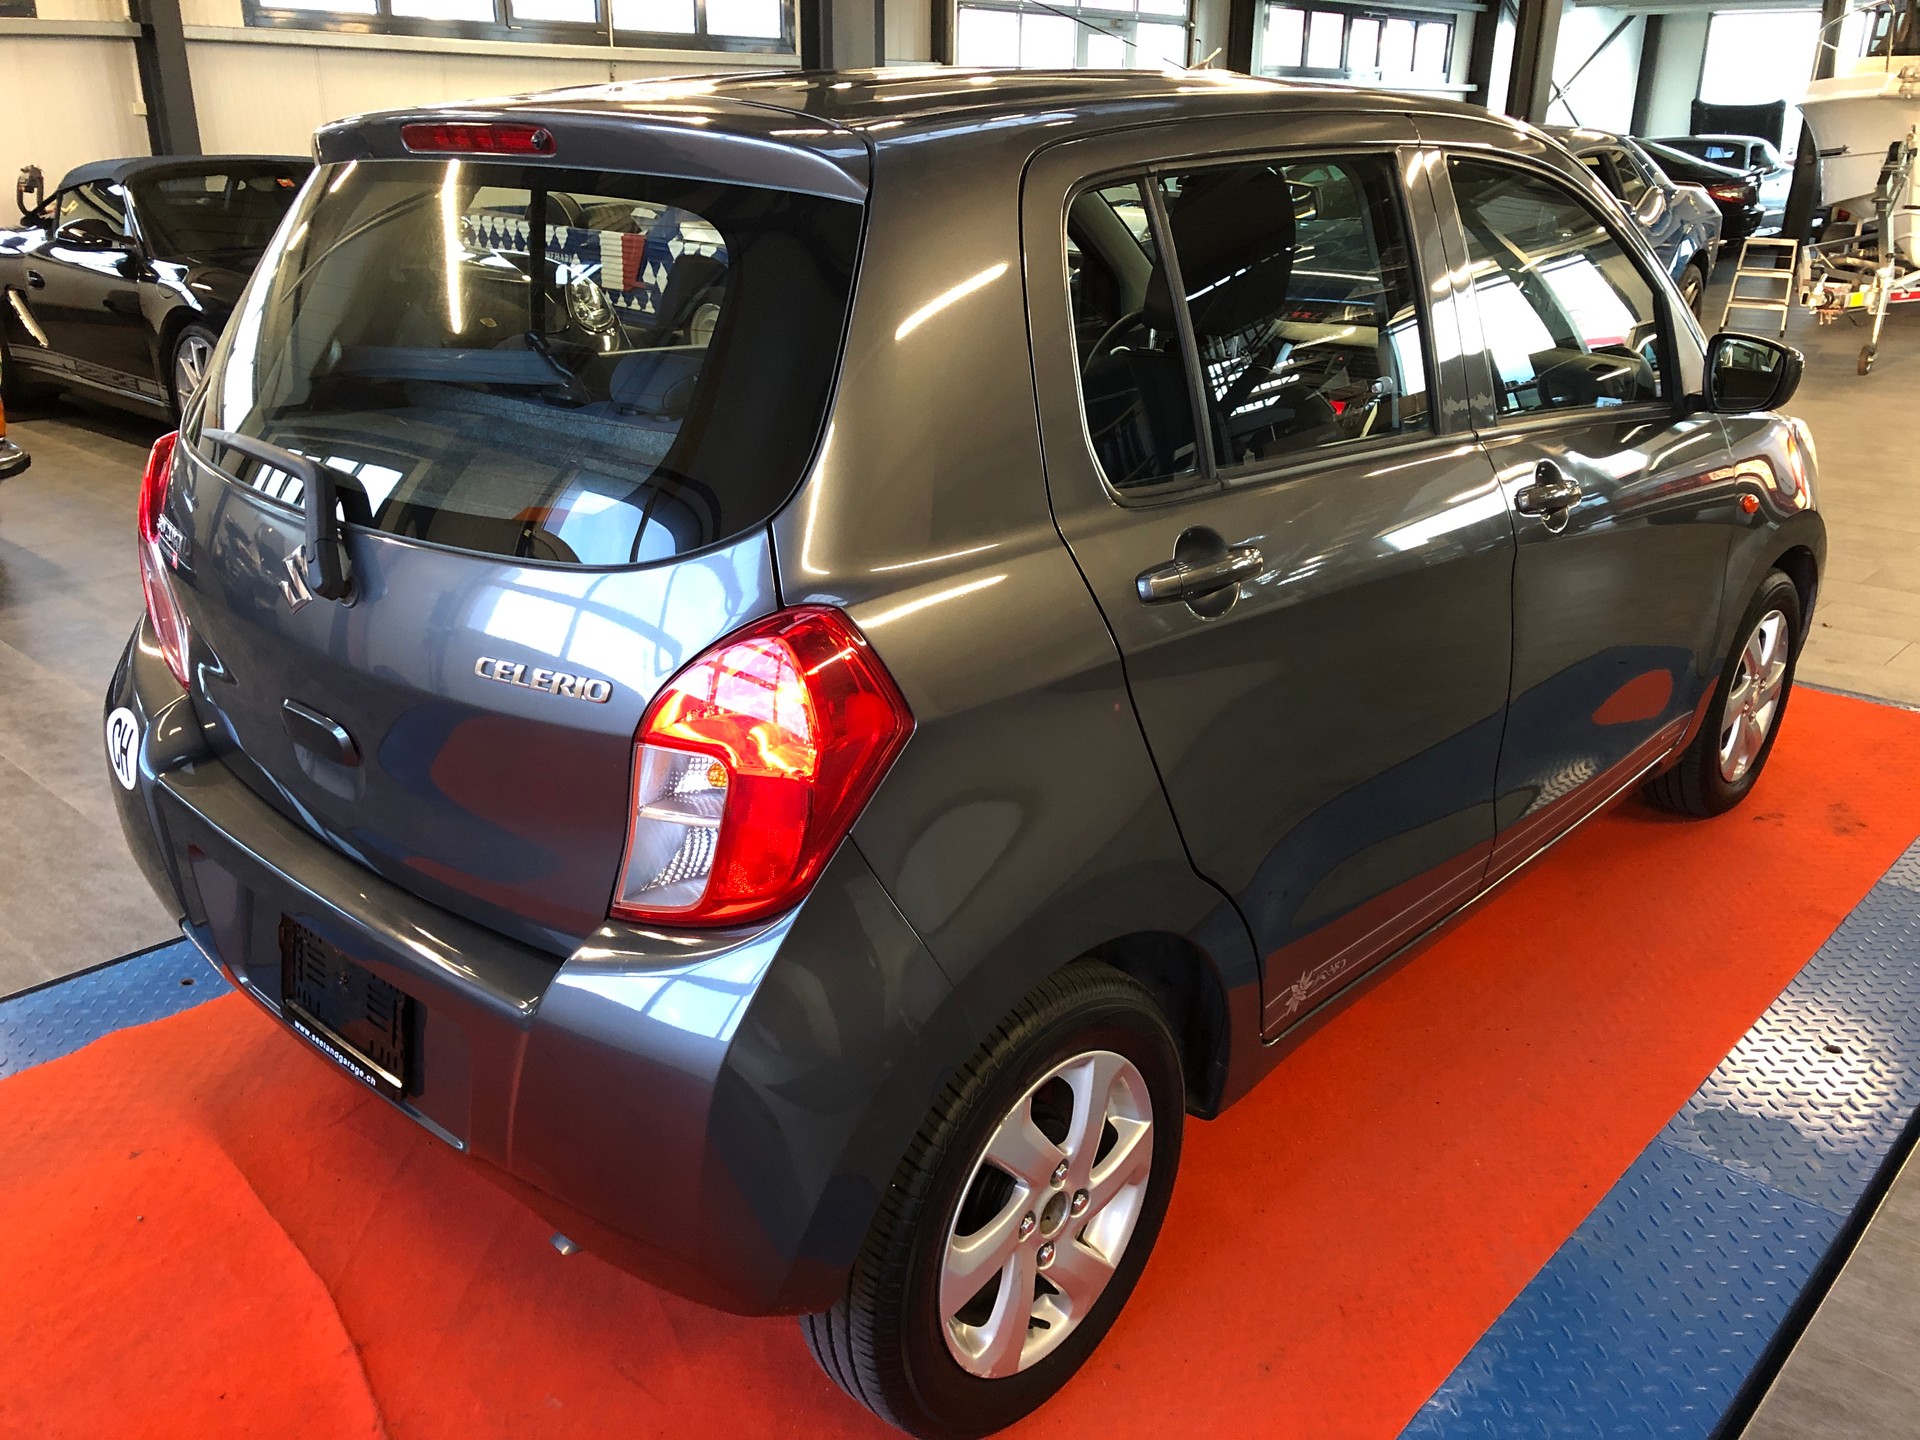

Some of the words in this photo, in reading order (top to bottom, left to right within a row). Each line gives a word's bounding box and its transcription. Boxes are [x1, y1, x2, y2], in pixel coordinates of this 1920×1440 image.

[474, 656, 613, 704] CELERIO
[112, 717, 134, 782] CH
[294, 1020, 376, 1087] www.seelandgarage.ch
